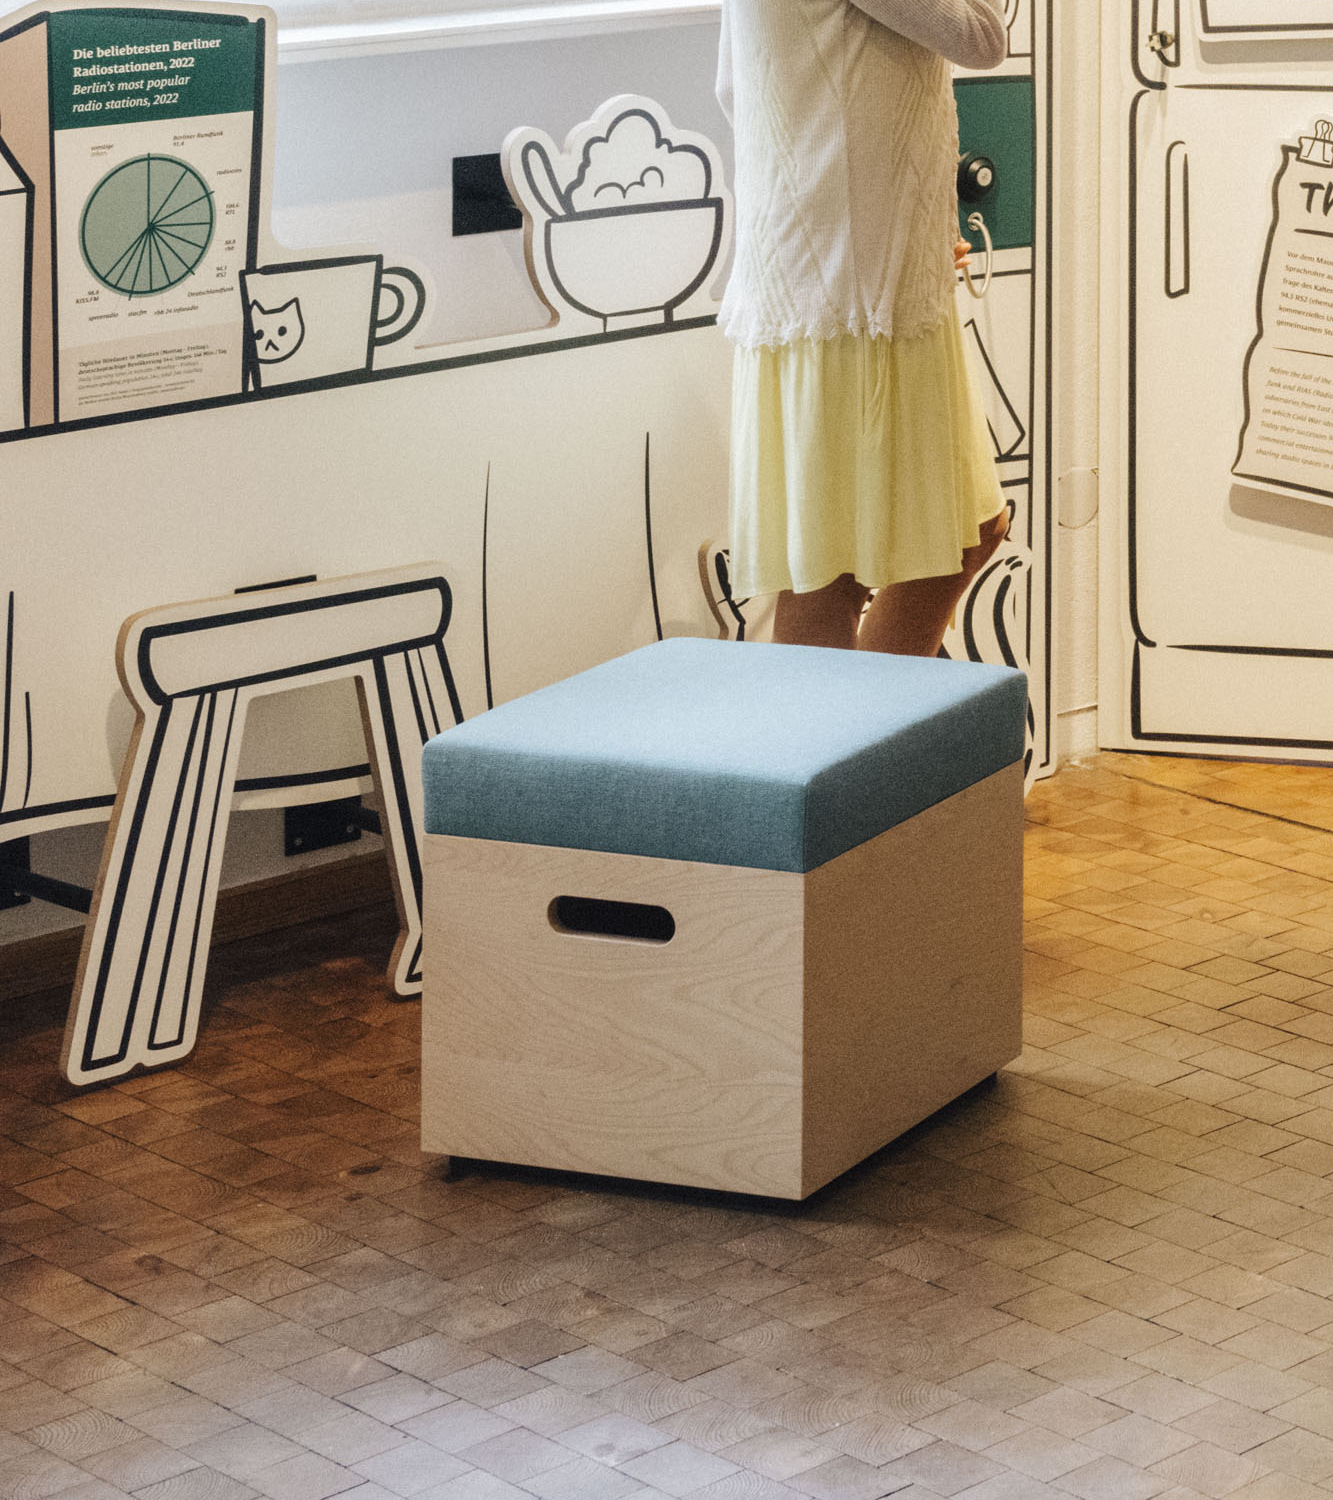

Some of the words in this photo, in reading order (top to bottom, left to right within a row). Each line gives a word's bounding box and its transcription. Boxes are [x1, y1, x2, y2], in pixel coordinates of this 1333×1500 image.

[73, 48, 94, 60] Die
[96, 42, 170, 58] beliebtesten
[173, 38, 222, 51] Berliner
[73, 62, 168, 77] Radiostationen,
[169, 57, 195, 69] 2022
[117, 78, 145, 91] most
[146, 75, 191, 91] popular
[72, 100, 103, 113] radio
[105, 96, 151, 110] stations,
[153, 93, 179, 106] 2022
[1287, 251, 1298, 259] Vor
[1300, 253, 1315, 262] dem
[1285, 264, 1326, 279] Sprachrohre
[1282, 277, 1300, 288] frage
[1300, 281, 1313, 290] des
